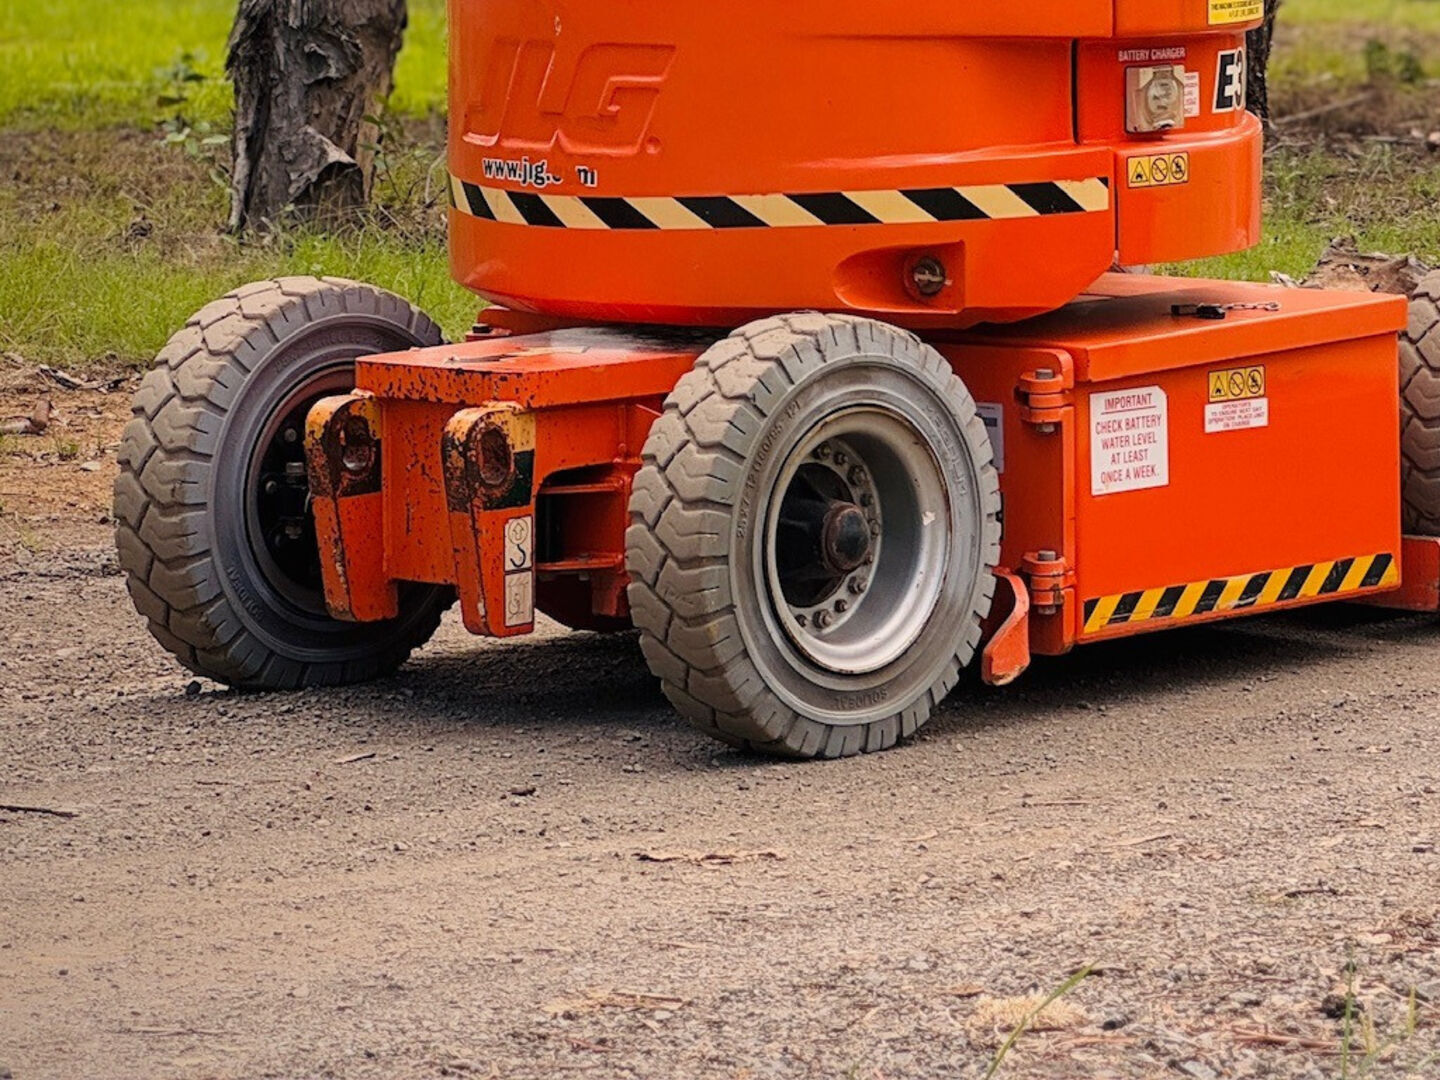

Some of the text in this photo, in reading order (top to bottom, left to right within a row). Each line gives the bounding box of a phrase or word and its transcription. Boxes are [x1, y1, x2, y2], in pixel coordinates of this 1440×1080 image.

[1118, 47, 1186, 61] BATTERY CHARGER
[462, 37, 677, 155] JLG
[1104, 393, 1152, 410] IMPORTANT
[1095, 414, 1162, 435] CHECK BATTERY
[1101, 431, 1157, 450] WATER LEVEL
[1111, 449, 1148, 465] AT LEAST
[1101, 468, 1122, 484] ONCE
[1125, 468, 1131, 480] A
